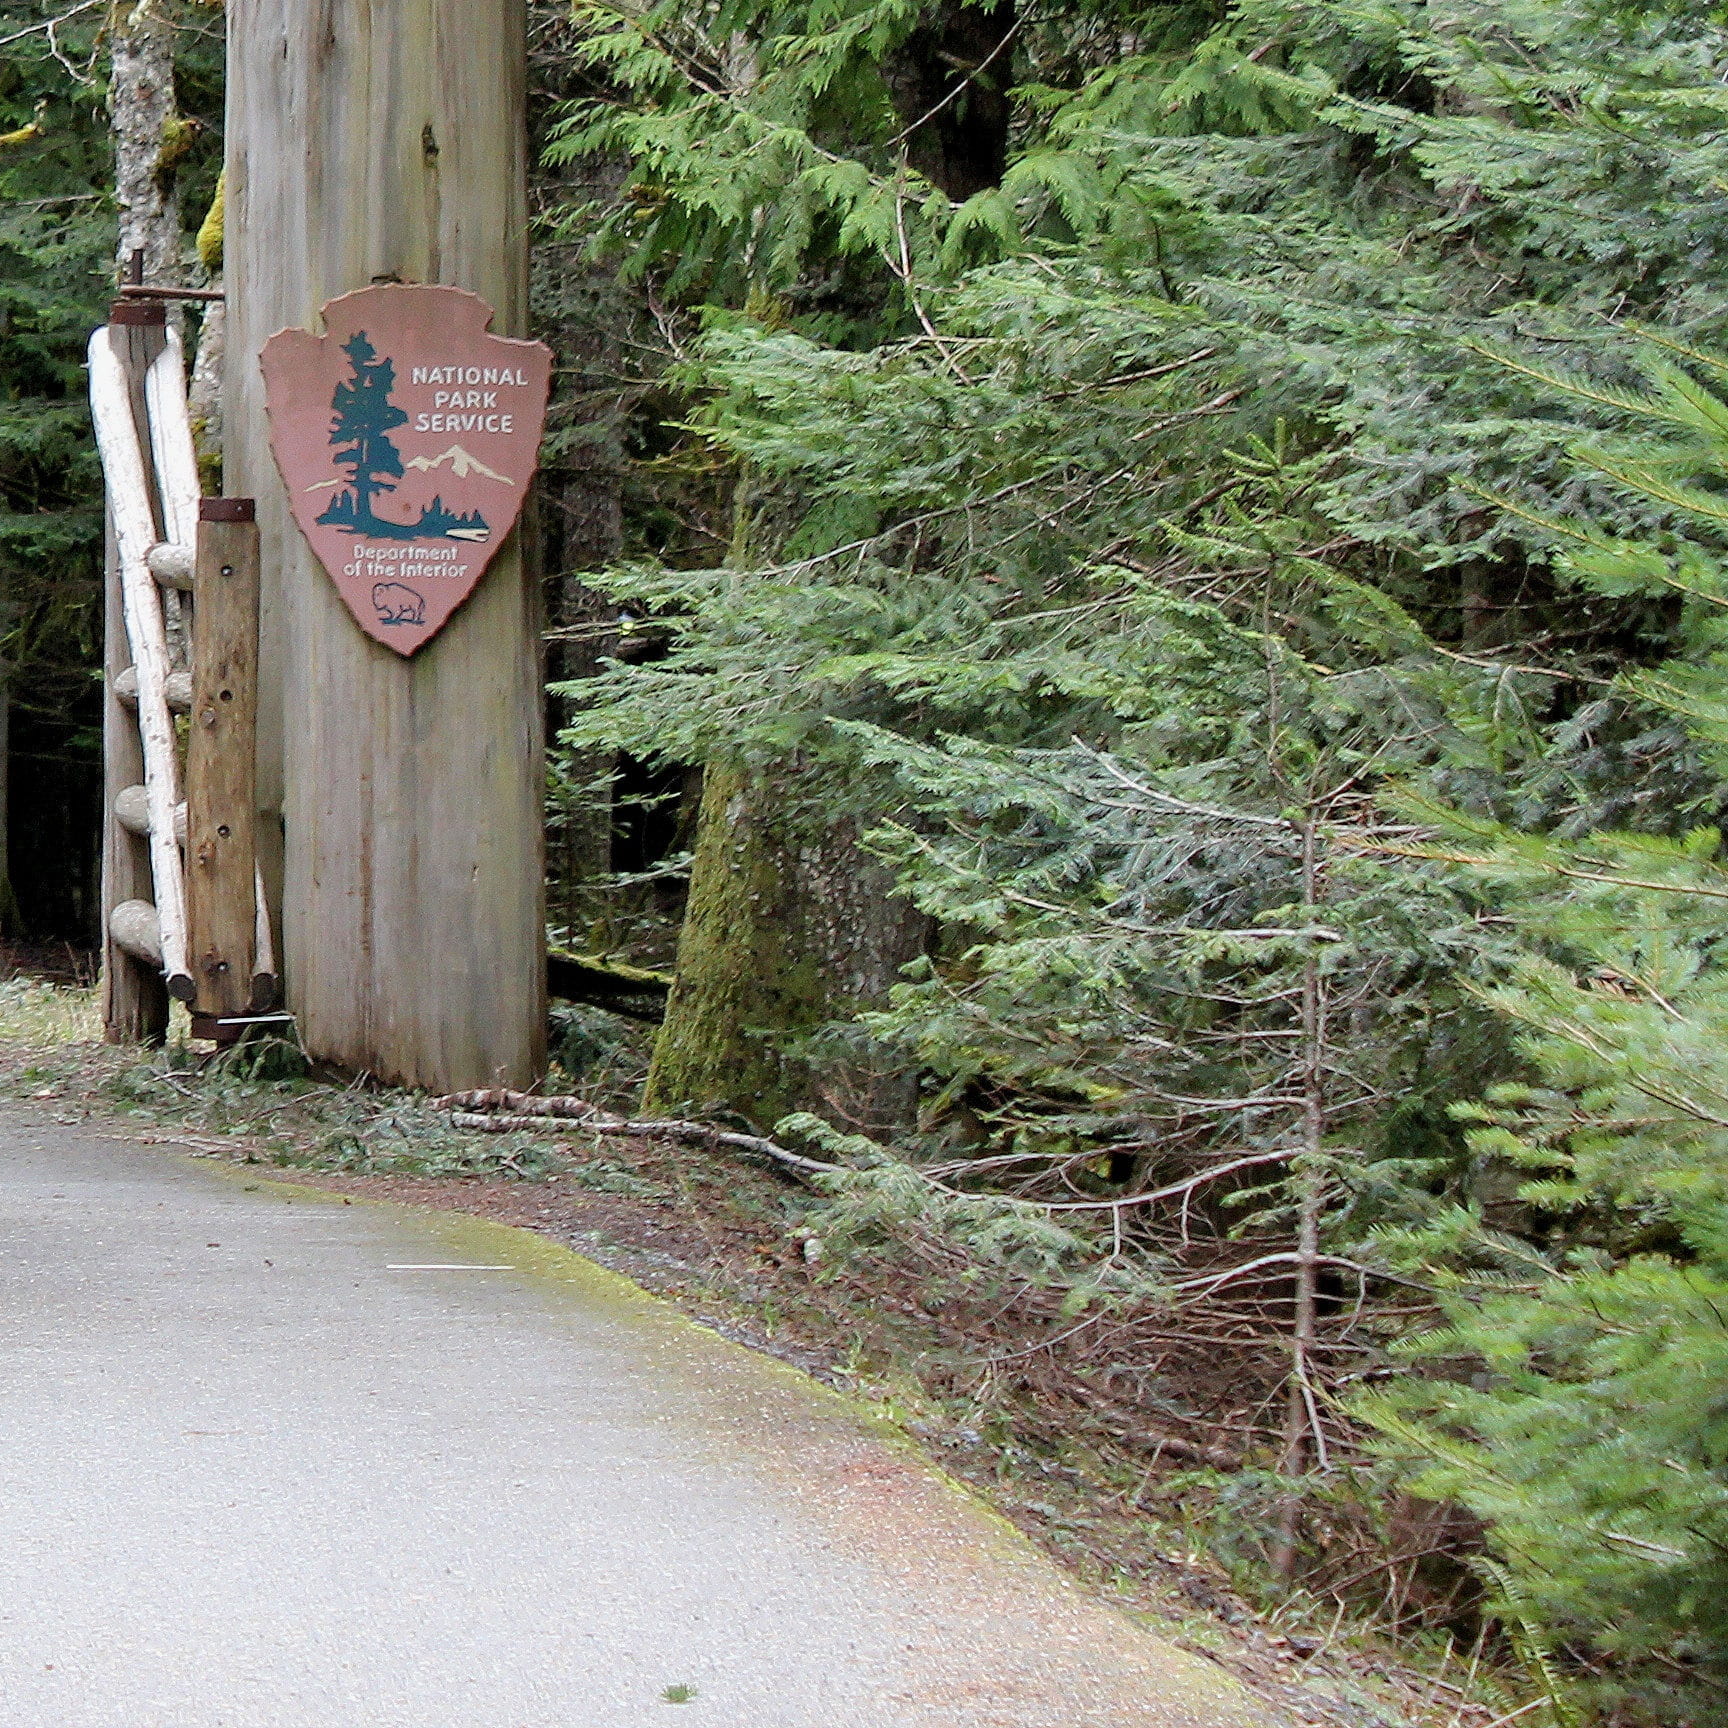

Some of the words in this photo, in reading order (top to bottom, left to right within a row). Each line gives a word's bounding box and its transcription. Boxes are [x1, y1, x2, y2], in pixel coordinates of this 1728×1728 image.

[411, 365, 529, 387] NATIONAL
[434, 390, 498, 409] PARK
[414, 412, 514, 433] SERVICE
[352, 544, 459, 562] Department
[342, 559, 362, 577] of
[366, 561, 396, 577] the
[400, 561, 469, 577] Interior
